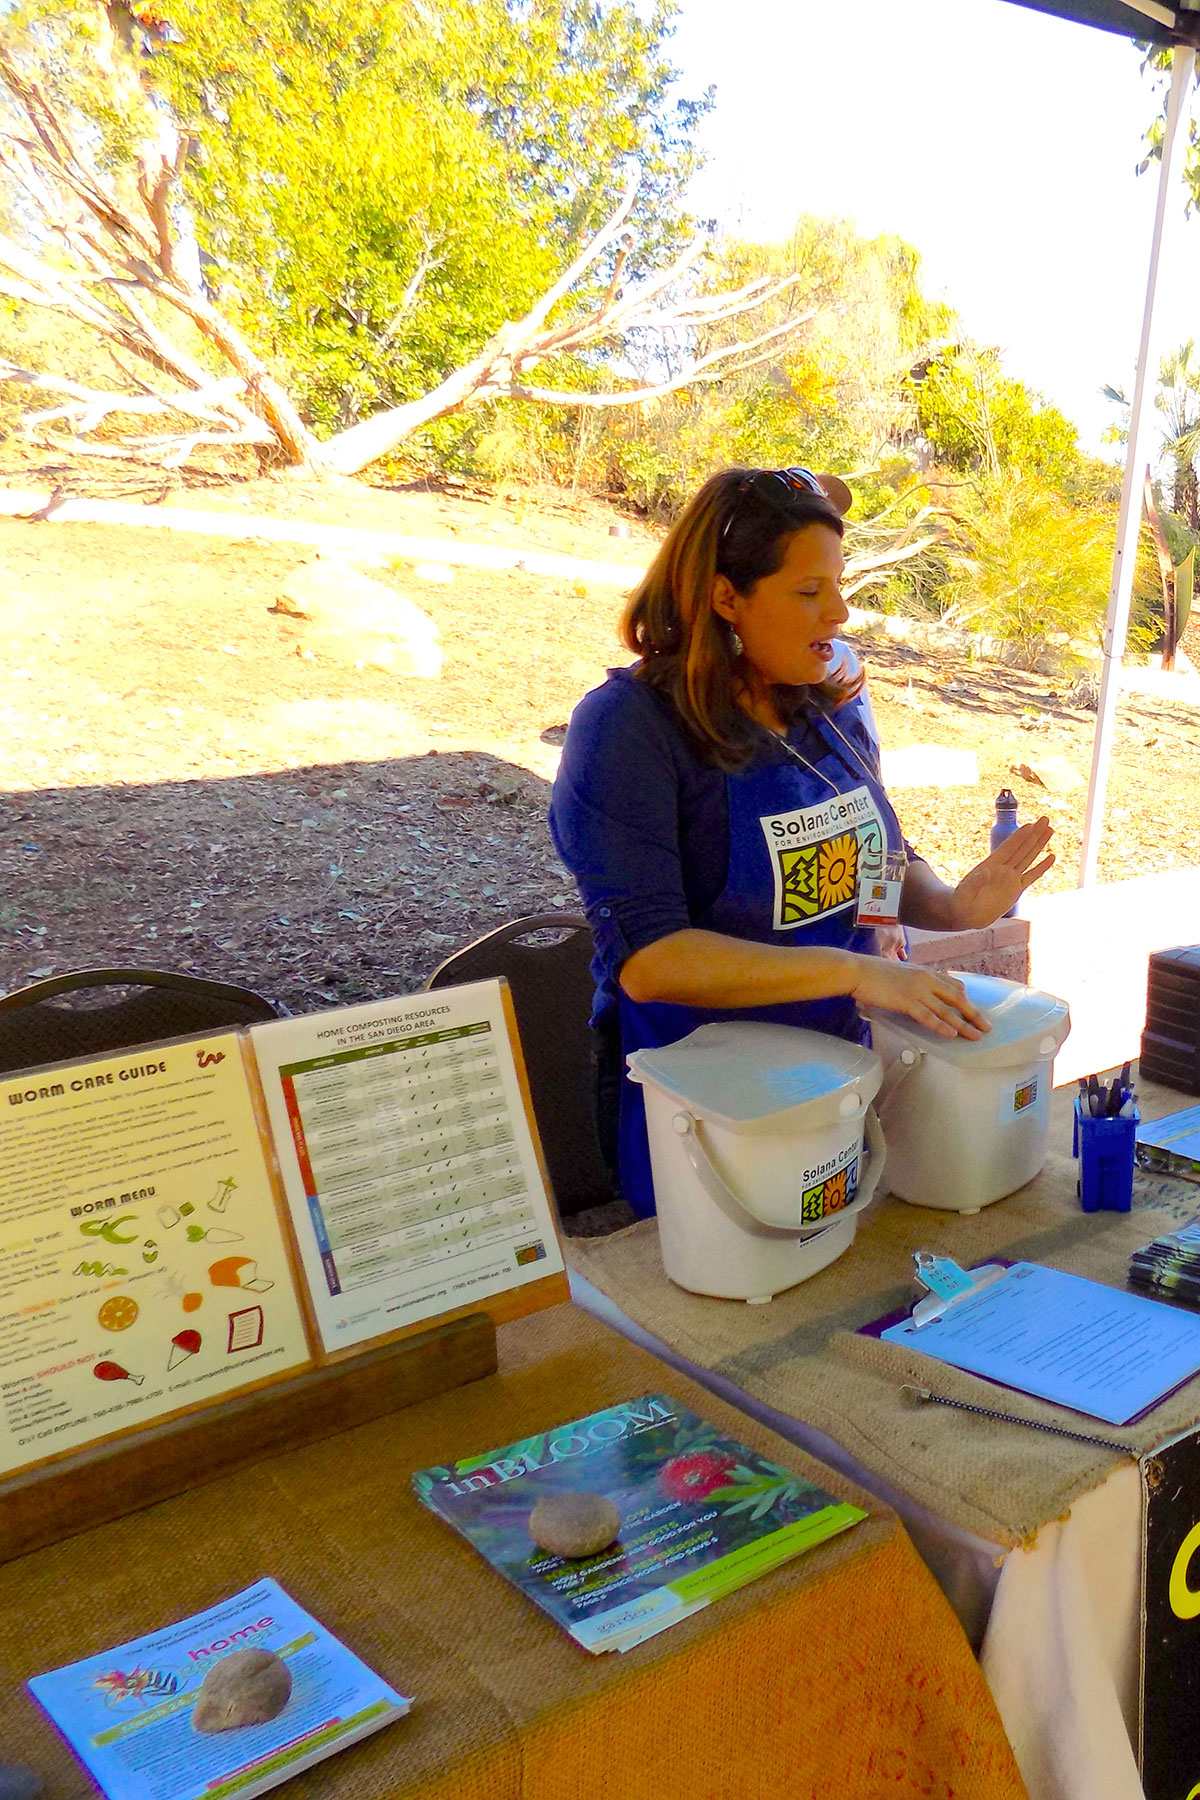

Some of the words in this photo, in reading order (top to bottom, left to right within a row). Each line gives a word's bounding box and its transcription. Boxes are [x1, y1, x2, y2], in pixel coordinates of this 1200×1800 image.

[317, 1026, 344, 1039] HOME
[347, 1014, 403, 1033] COMPOSTING
[405, 1005, 451, 1021] RESOURCES
[337, 1038, 347, 1046] IN
[350, 1033, 365, 1044] THE
[368, 1029, 385, 1039] SAN
[387, 1023, 413, 1035] DIEGO
[414, 1019, 436, 1031] AREA
[8, 1083, 65, 1106] WORM
[70, 1073, 114, 1092] CARE
[118, 1061, 167, 1082] GUIDE
[803, 1158, 836, 1182] Solana
[70, 1197, 116, 1217] WORM
[119, 1186, 156, 1202] MENU
[37, 1429, 53, 1438] Call
[644, 1501, 682, 1522] GARDEN
[552, 1573, 578, 1587] HOW
[579, 1554, 627, 1577] GARDENS
[628, 1544, 647, 1556] ARE
[648, 1531, 676, 1550] GOOD
[677, 1521, 697, 1534] FOR
[698, 1511, 718, 1523] YOU
[566, 1571, 627, 1597] GARDEN
[572, 1576, 634, 1604] EXPERIENCE
[635, 1563, 664, 1579] MORE
[665, 1552, 685, 1566] AND
[687, 1541, 710, 1557] SAVE
[187, 1616, 275, 1662] home
